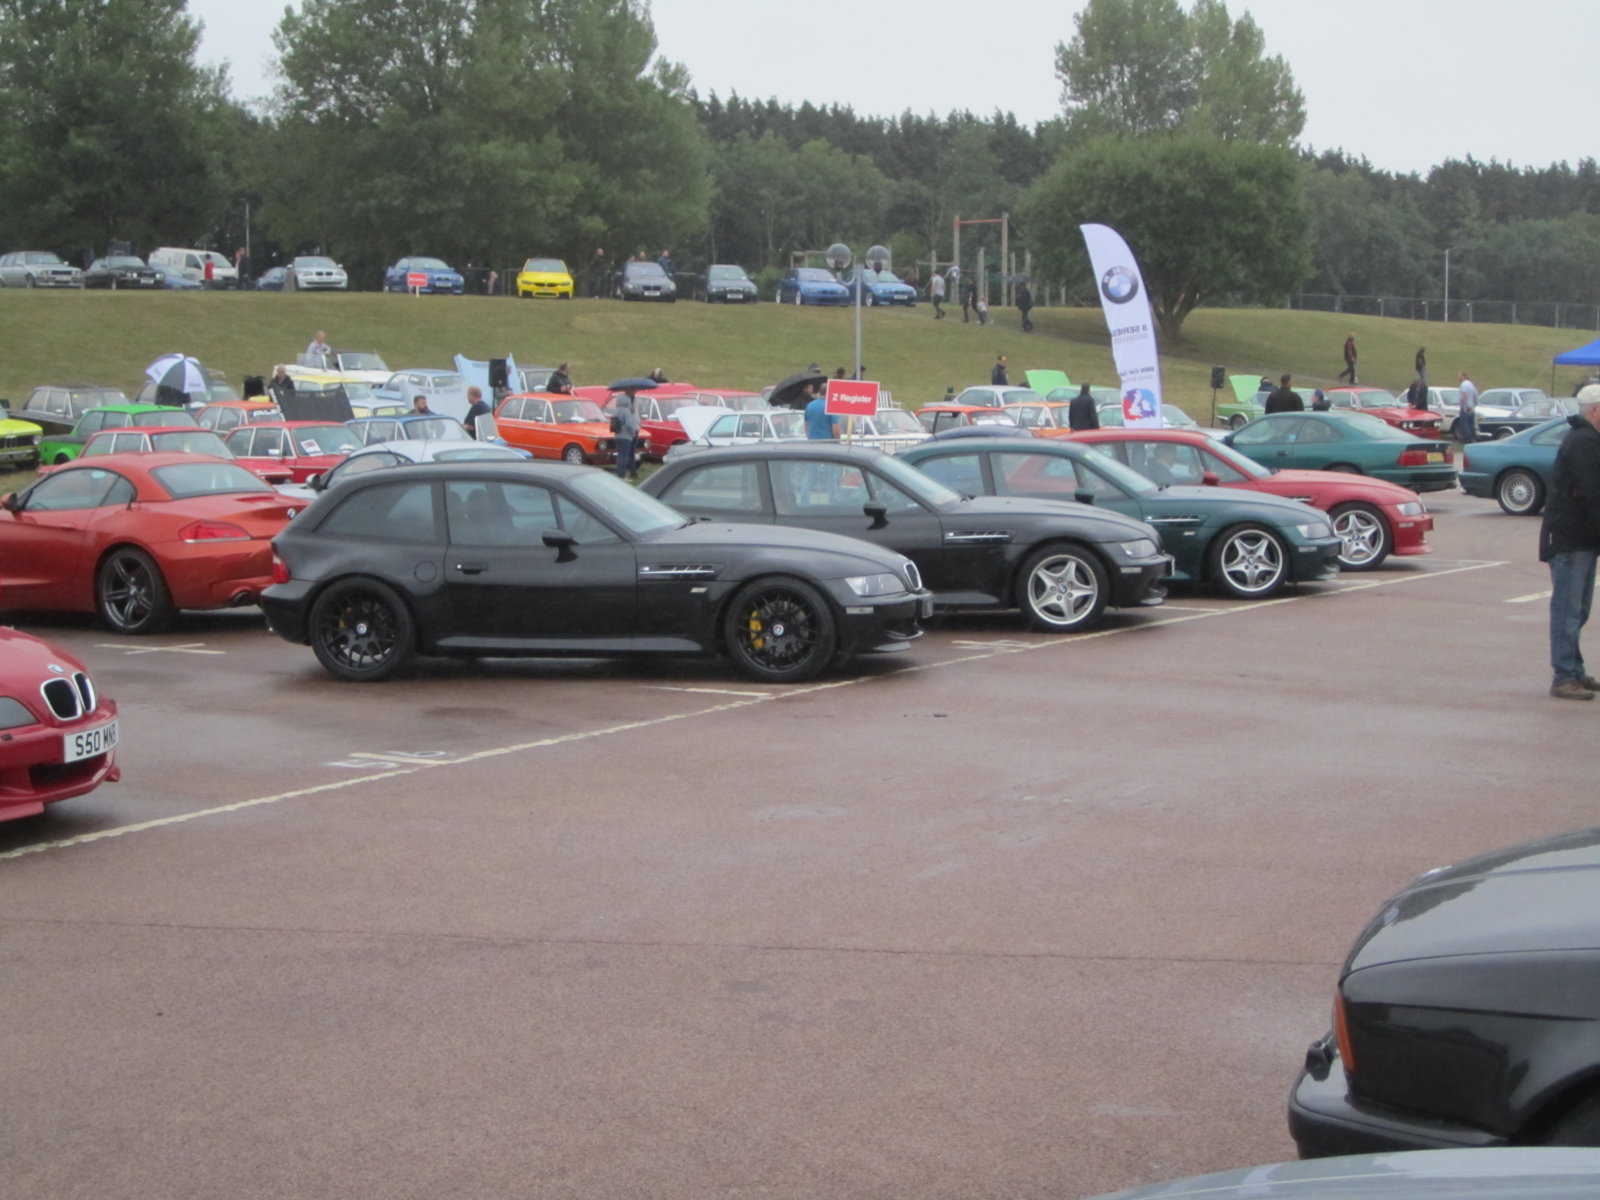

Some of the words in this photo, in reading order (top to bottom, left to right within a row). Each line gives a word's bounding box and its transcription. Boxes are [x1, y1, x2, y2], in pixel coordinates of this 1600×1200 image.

[832, 393, 839, 402] Z
[840, 393, 872, 404] Register
[75, 730, 101, 757] S50
